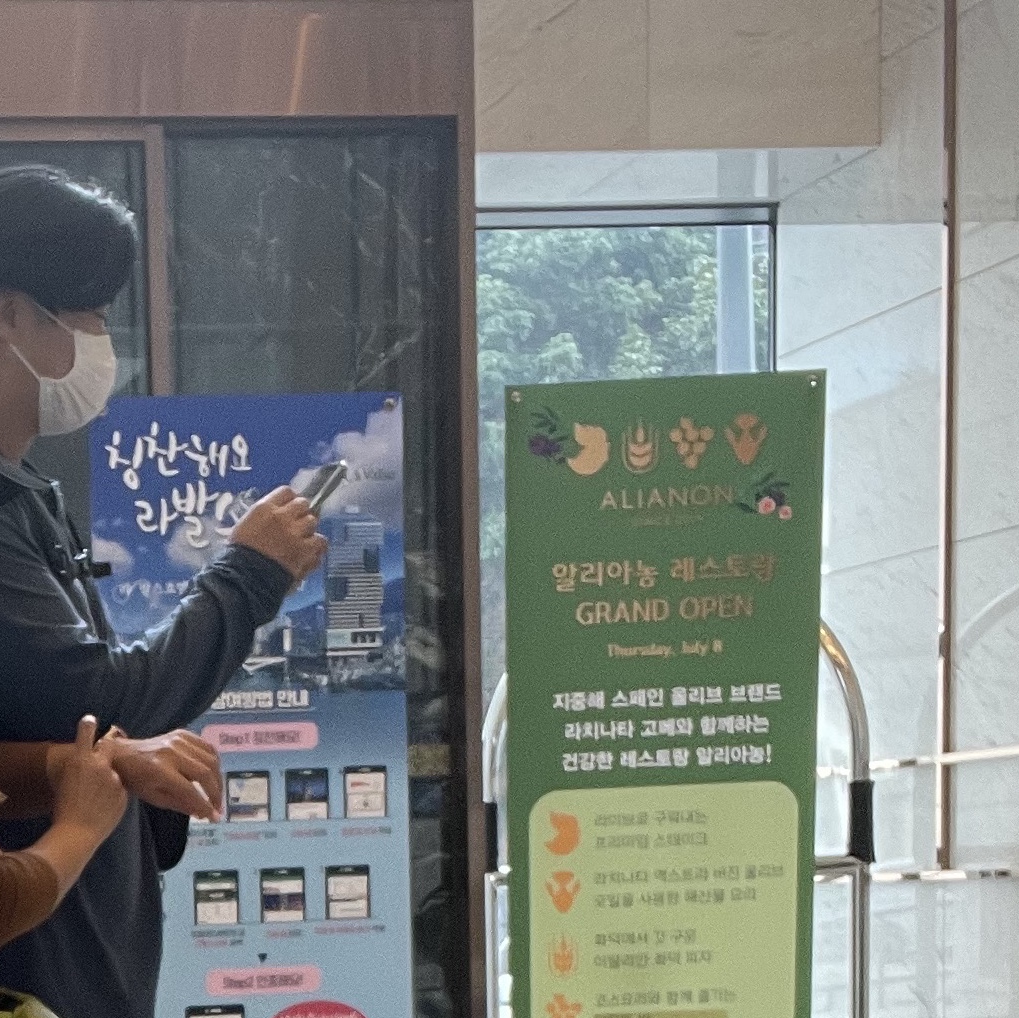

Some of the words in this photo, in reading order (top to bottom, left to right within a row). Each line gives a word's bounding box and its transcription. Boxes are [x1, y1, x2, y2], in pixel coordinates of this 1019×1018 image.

[105, 421, 252, 490] 칭찬해요
[600, 485, 733, 509] ALIANON
[552, 560, 659, 592] 알리아농
[670, 554, 776, 582] 레스토랑
[575, 599, 670, 625] GRAND
[679, 595, 754, 620] OPEN
[682, 640, 708, 656] July
[552, 690, 605, 711] 지중해
[610, 688, 664, 709] 스페인
[671, 686, 723, 706] 올리브
[729, 683, 782, 702] 브랜드
[564, 720, 634, 741] 라치나타
[700, 714, 769, 736] 함께하는
[562, 751, 613, 772] 건강한
[620, 747, 689, 768] 레스토랑
[696, 743, 772, 766] 알리아농!
